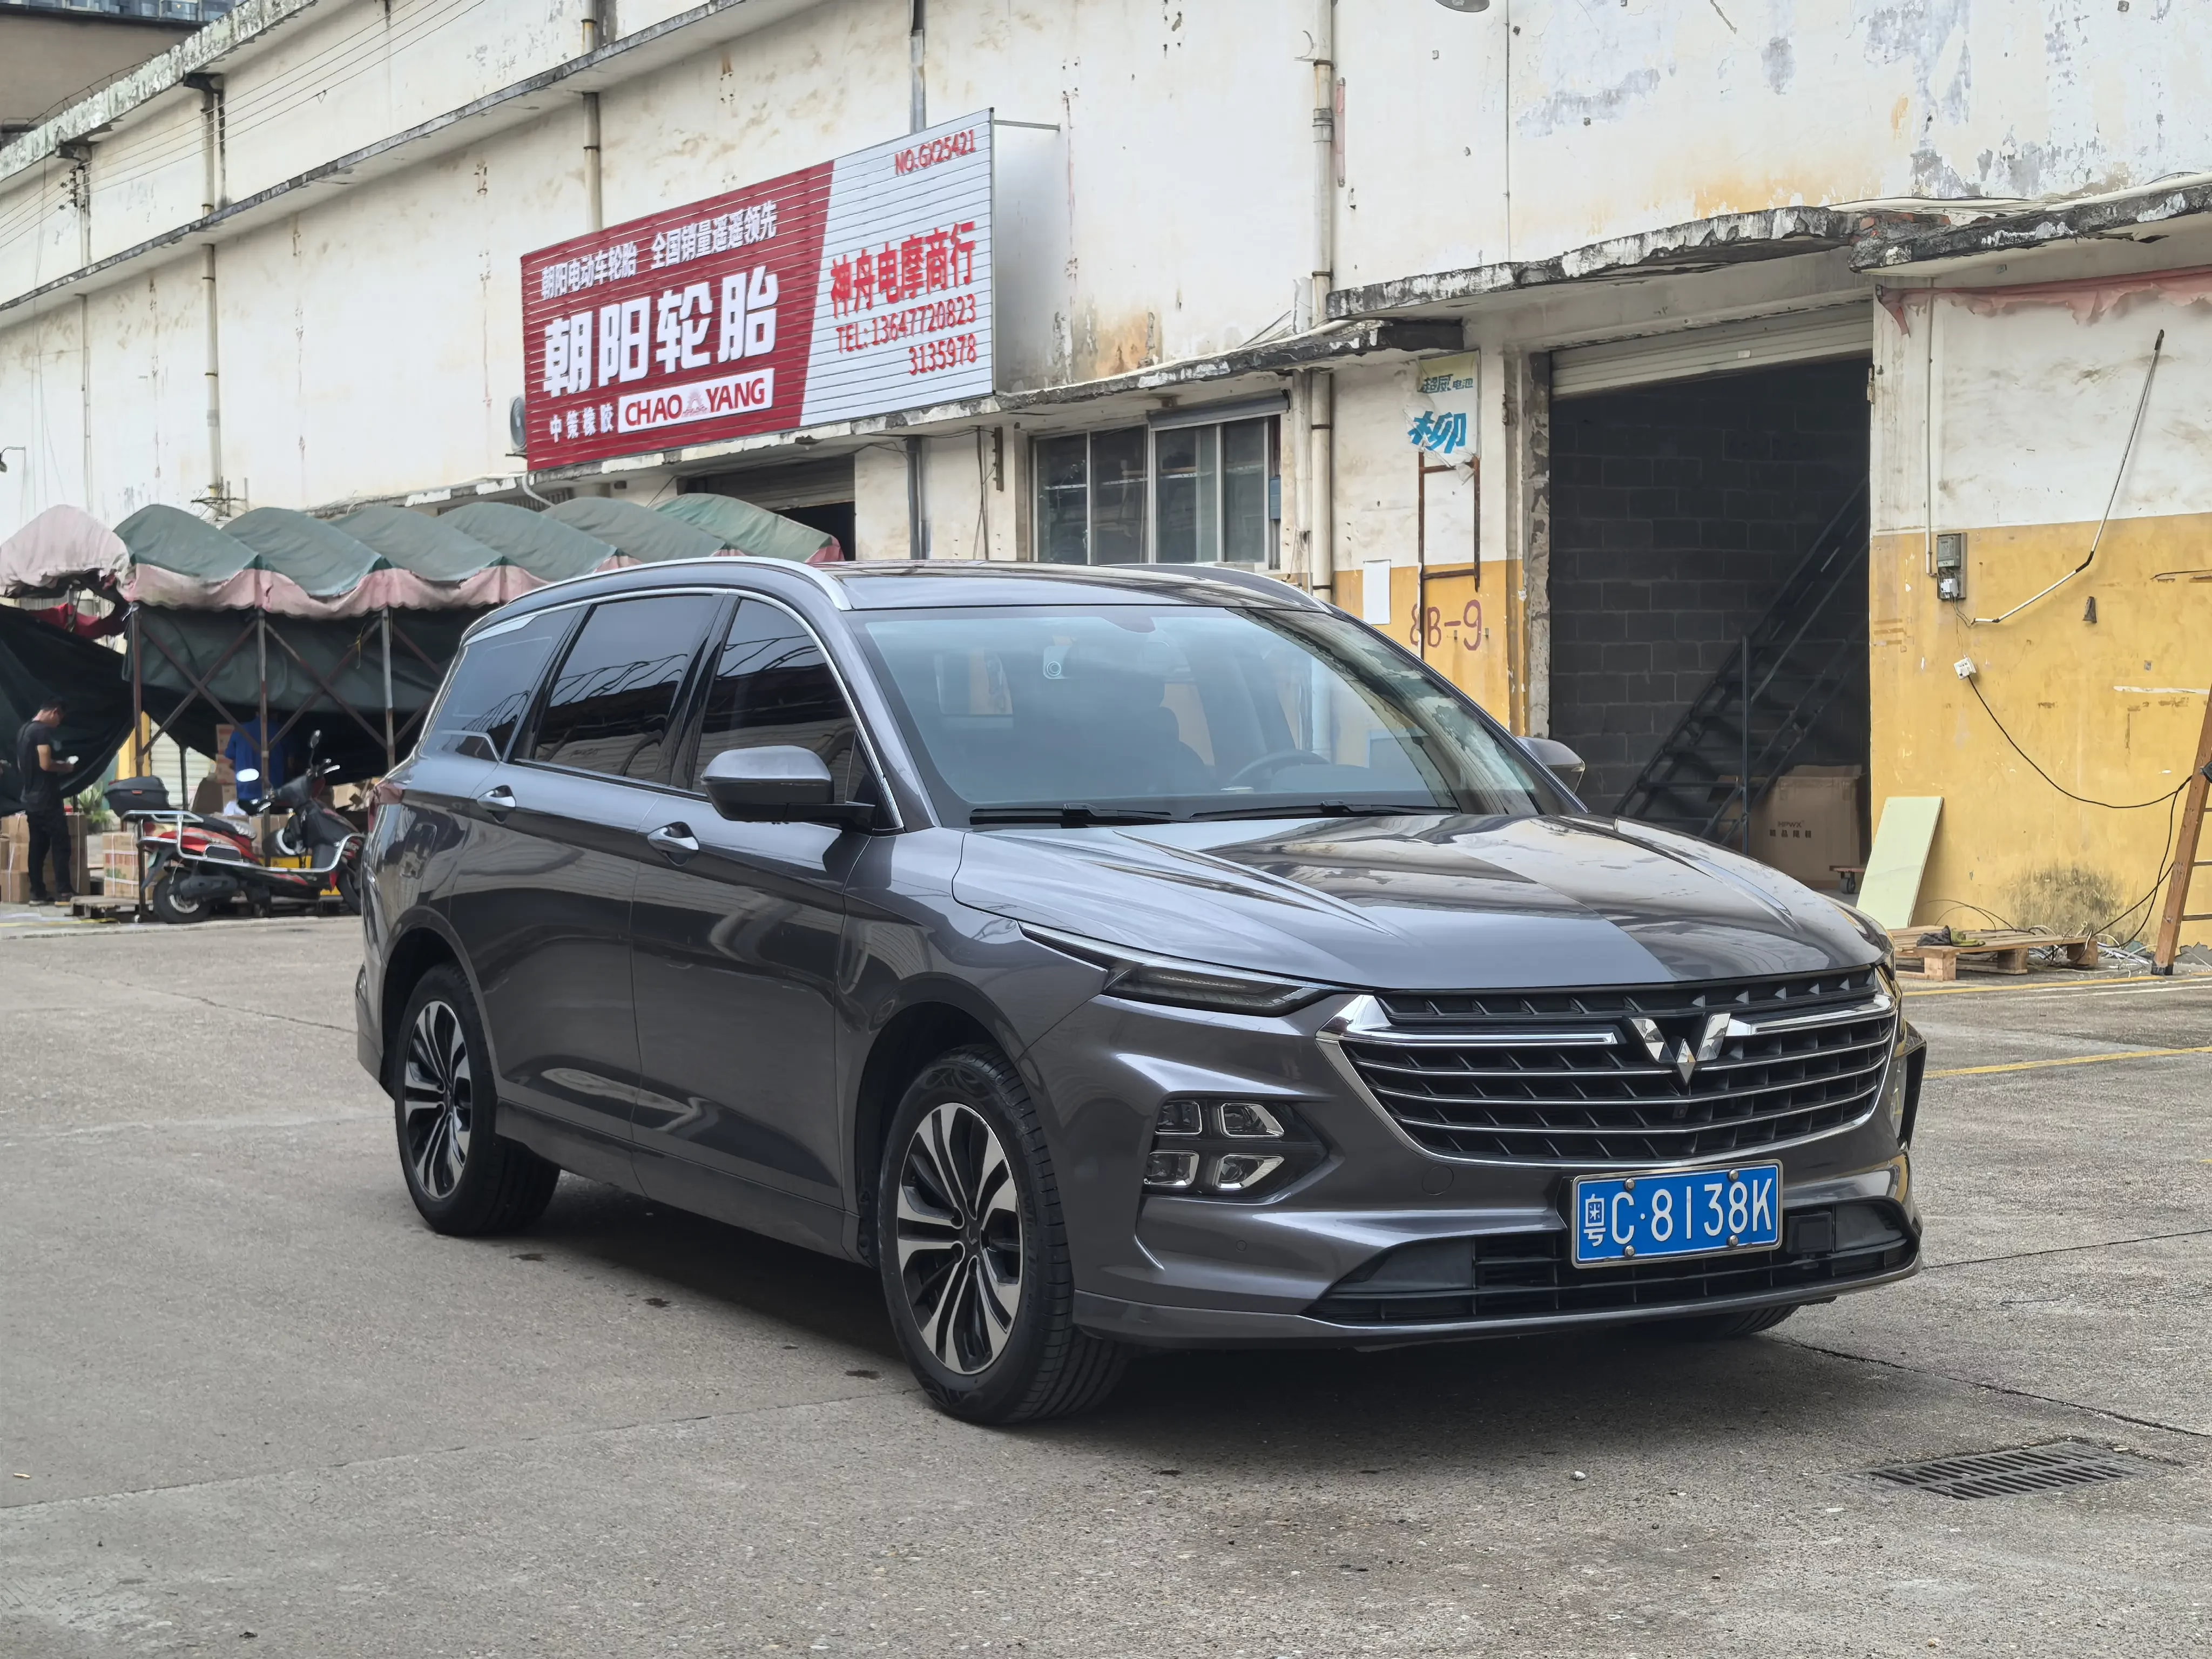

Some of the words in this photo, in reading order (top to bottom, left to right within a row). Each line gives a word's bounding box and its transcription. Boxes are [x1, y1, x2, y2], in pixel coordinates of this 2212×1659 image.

[541, 241, 638, 300] 朝阳电动车轮胎
[651, 200, 778, 269] 全国销量遥遥领先
[831, 221, 976, 319] 神舟电摩商行
[543, 265, 778, 398] 朝阳轮胎
[908, 333, 976, 375] 3135978
[625, 394, 683, 426] CHAO
[706, 377, 765, 413] YANG
[1407, 411, 1467, 454] 柳
